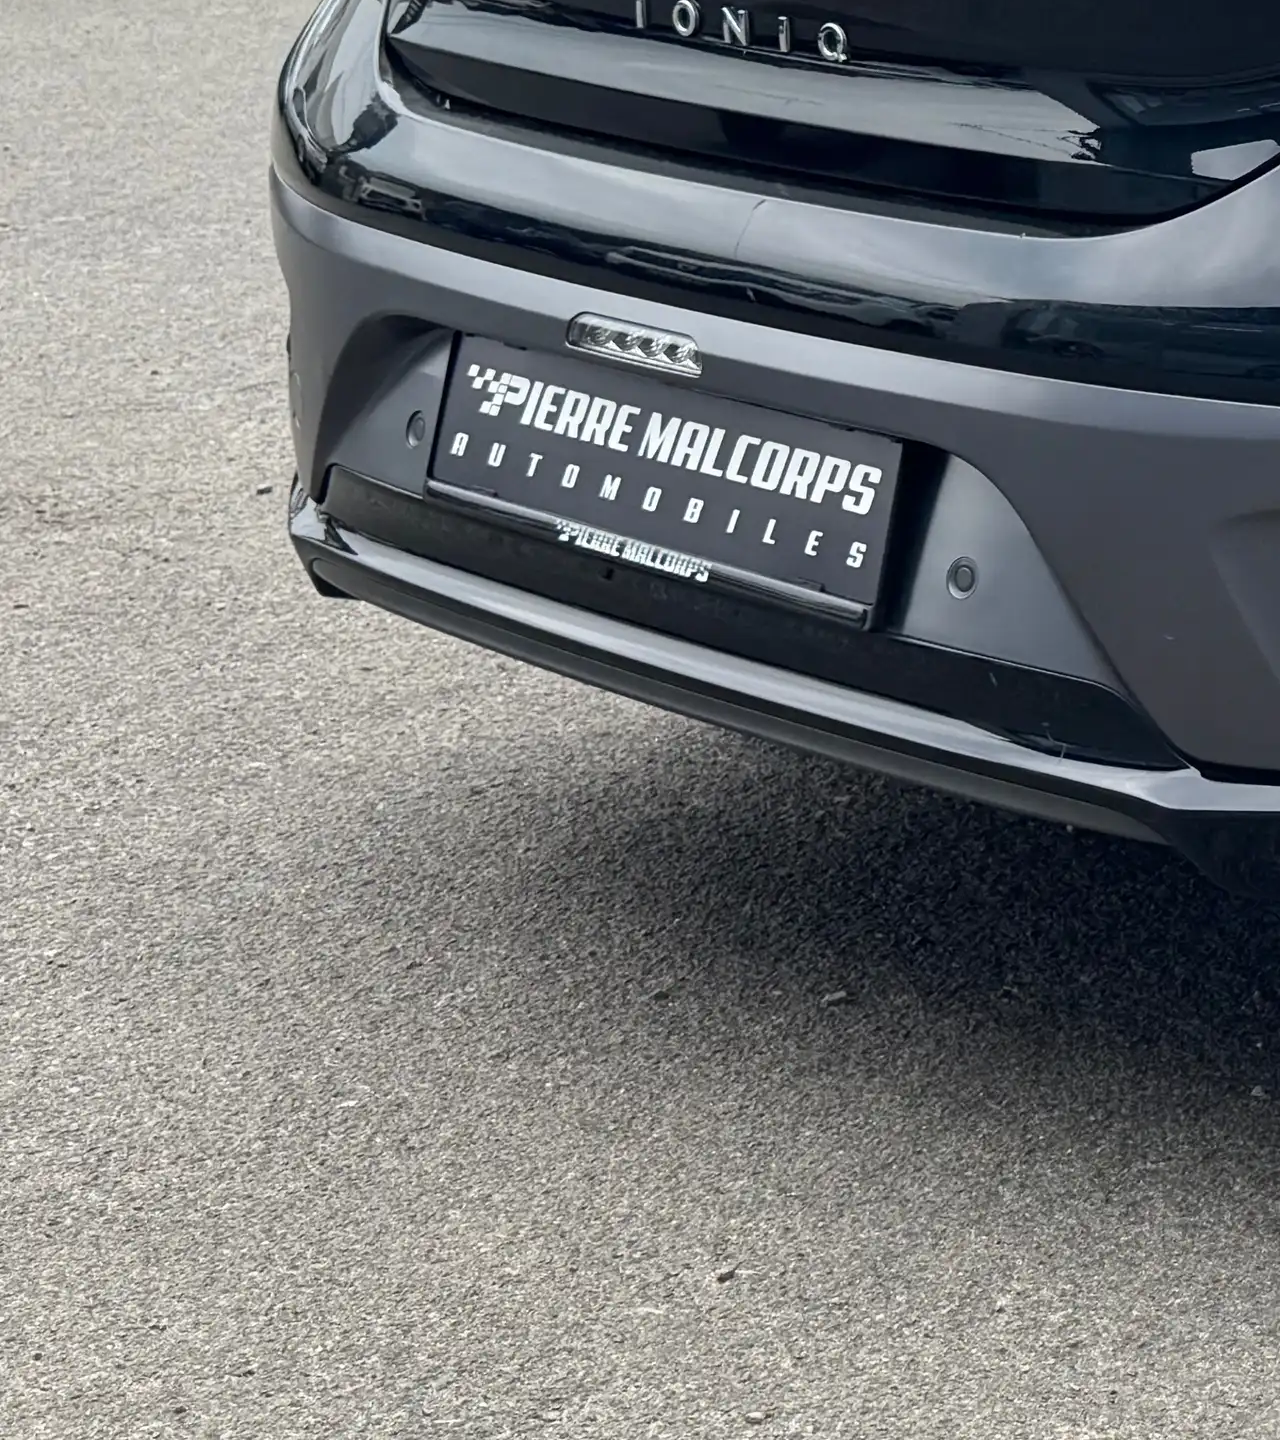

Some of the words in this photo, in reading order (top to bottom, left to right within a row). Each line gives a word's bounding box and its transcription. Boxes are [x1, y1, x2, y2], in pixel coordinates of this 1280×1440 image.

[450, 431, 868, 569] AUTOMOBILES
[479, 372, 642, 452] PIERRE
[637, 411, 883, 516] MALCORPS
[621, 539, 713, 583] MALCORPS
